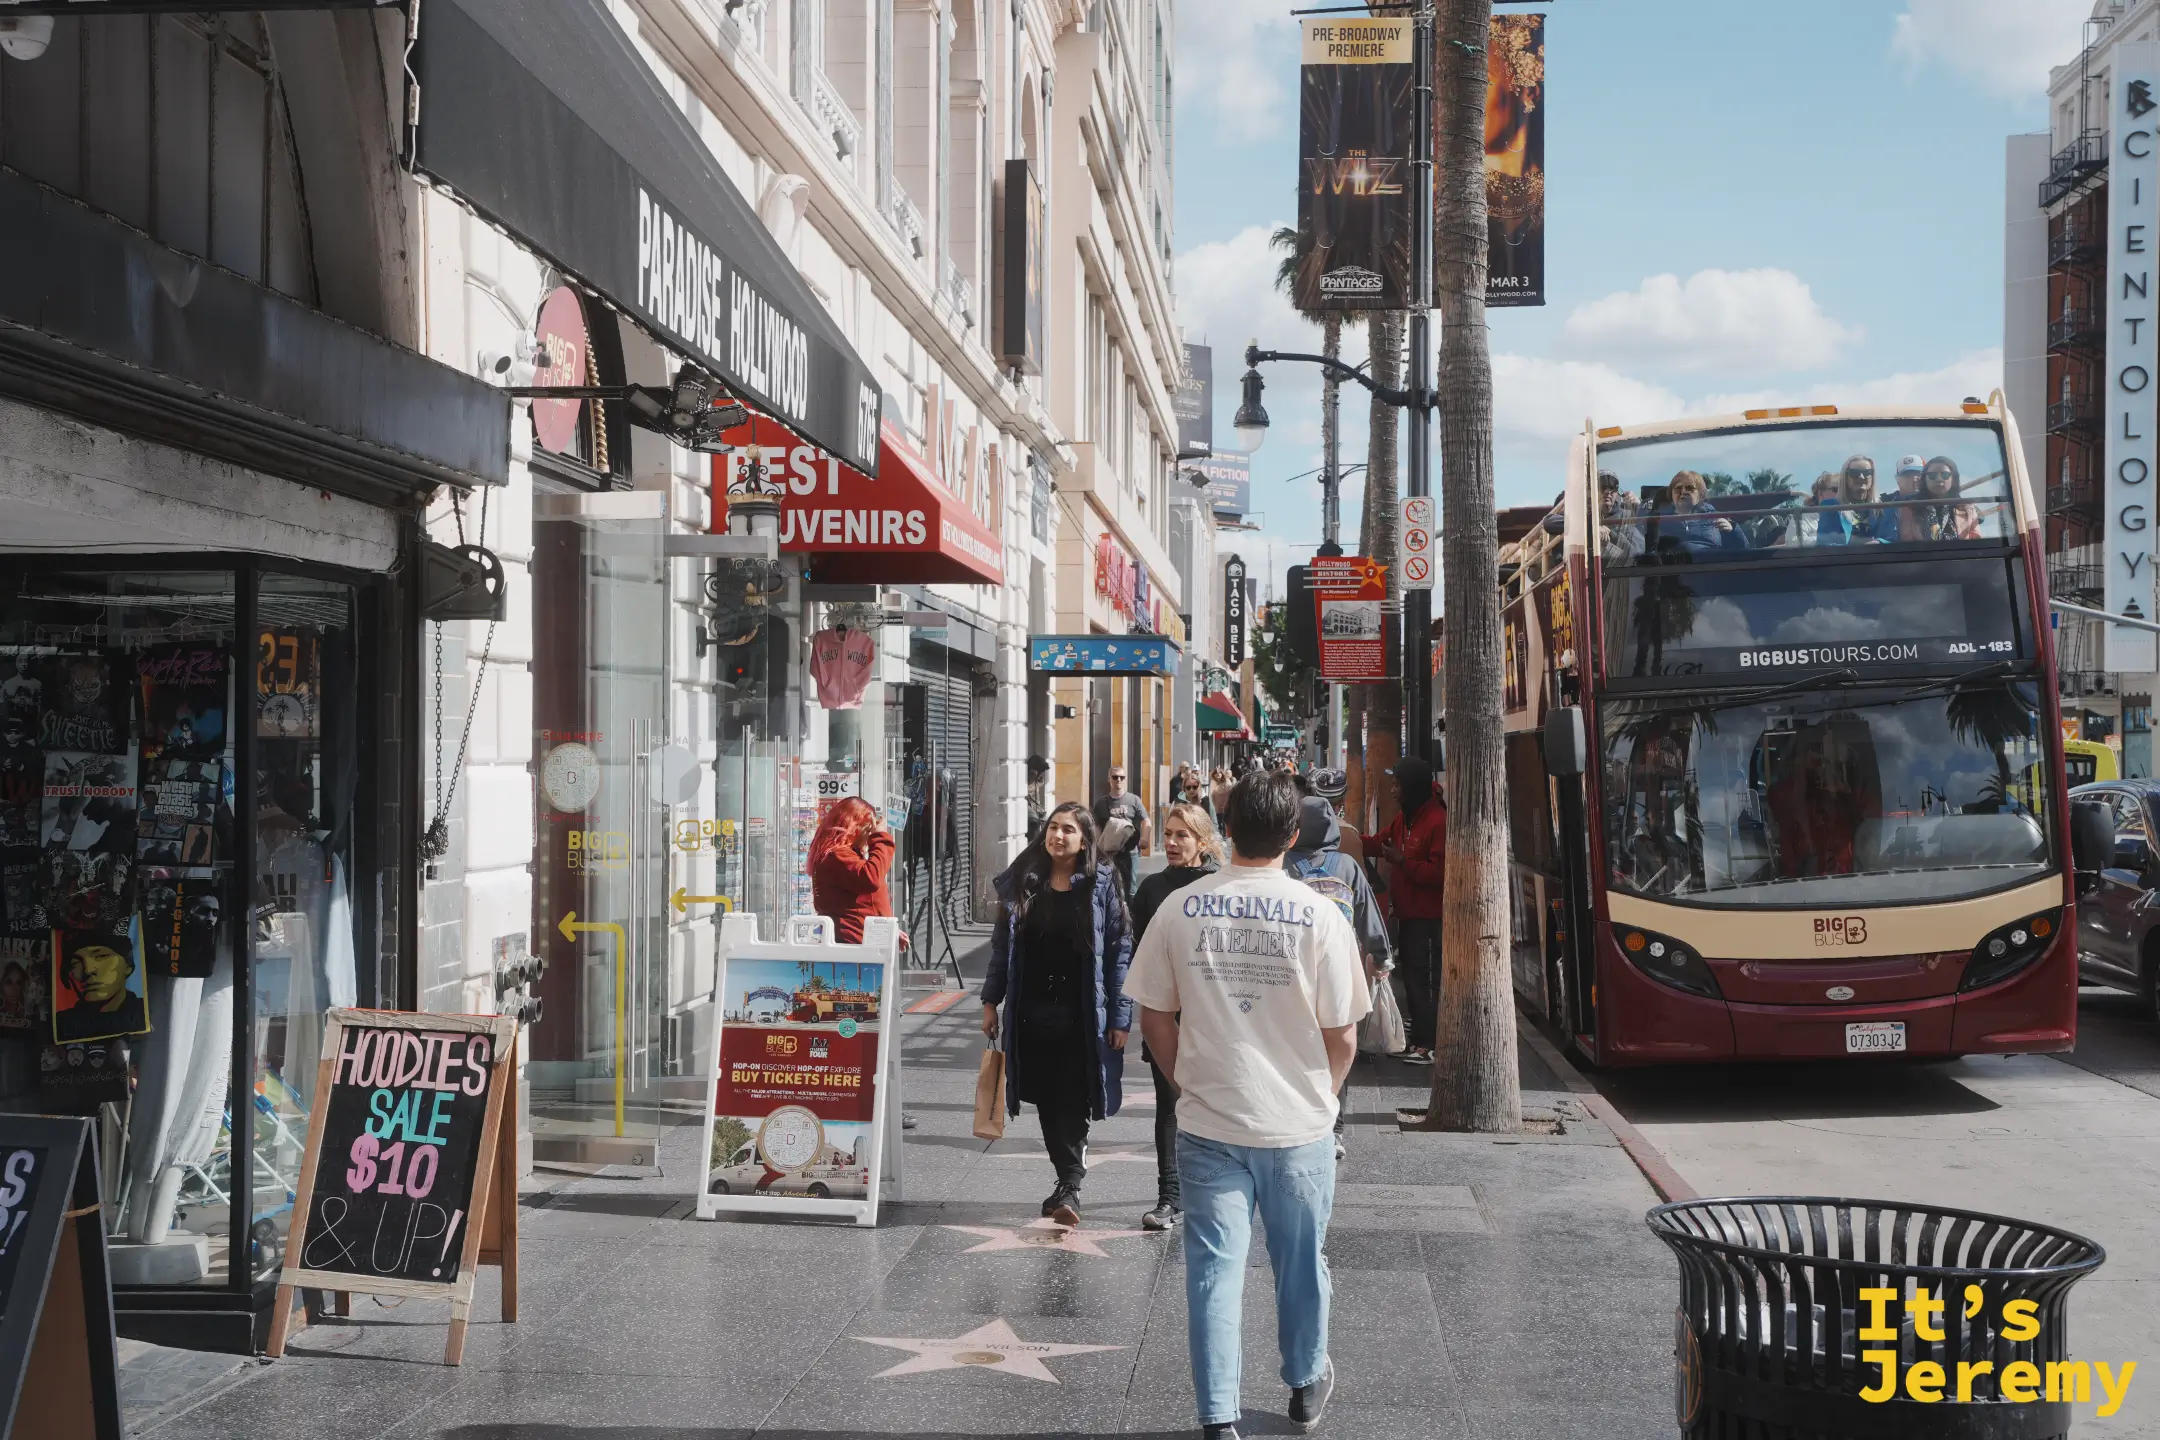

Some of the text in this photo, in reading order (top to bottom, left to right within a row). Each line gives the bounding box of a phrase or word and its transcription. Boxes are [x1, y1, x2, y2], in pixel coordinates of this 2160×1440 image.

[1312, 27, 1401, 41] PRE-BROADWAY
[1328, 43, 1385, 57] PREMIERE
[1304, 157, 1403, 195] WIZ
[1321, 276, 1382, 288] PANTAGES
[1491, 276, 1529, 287] MAR 3
[638, 187, 809, 421] PARADISE HOLLYWOOD
[858, 381, 878, 468] 6765
[1189, 440, 1208, 450] max
[1210, 466, 1249, 482] FICTION
[726, 509, 927, 545] UVENIRS
[1230, 578, 1239, 664] TACO BELL
[1740, 644, 1918, 667] BIGBUSTOURS.COM
[1949, 642, 1976, 654] ADL
[1988, 641, 2012, 652] 183
[45, 786, 135, 798] TRUST NOBODY
[887, 797, 909, 811] OPEN
[568, 831, 602, 850] BIG
[568, 851, 602, 869] BUS
[1183, 895, 1315, 928] ORIGINALS
[171, 882, 185, 974] LEGENDS
[1814, 917, 1843, 932] BIG
[1196, 926, 1298, 960] ATELIER
[1815, 933, 1844, 947] BUS
[766, 1043, 783, 1053] BUS
[767, 1035, 783, 1044] BIG
[1850, 1033, 1902, 1048] 07303J2
[335, 1028, 490, 1097] HOODIES
[830, 1066, 861, 1074] EXPLORE
[732, 1070, 861, 1087] BUY TICKETS HERE
[364, 1088, 456, 1145] SALE
[346, 1133, 438, 1198] $10
[304, 1196, 464, 1277] & UP!
